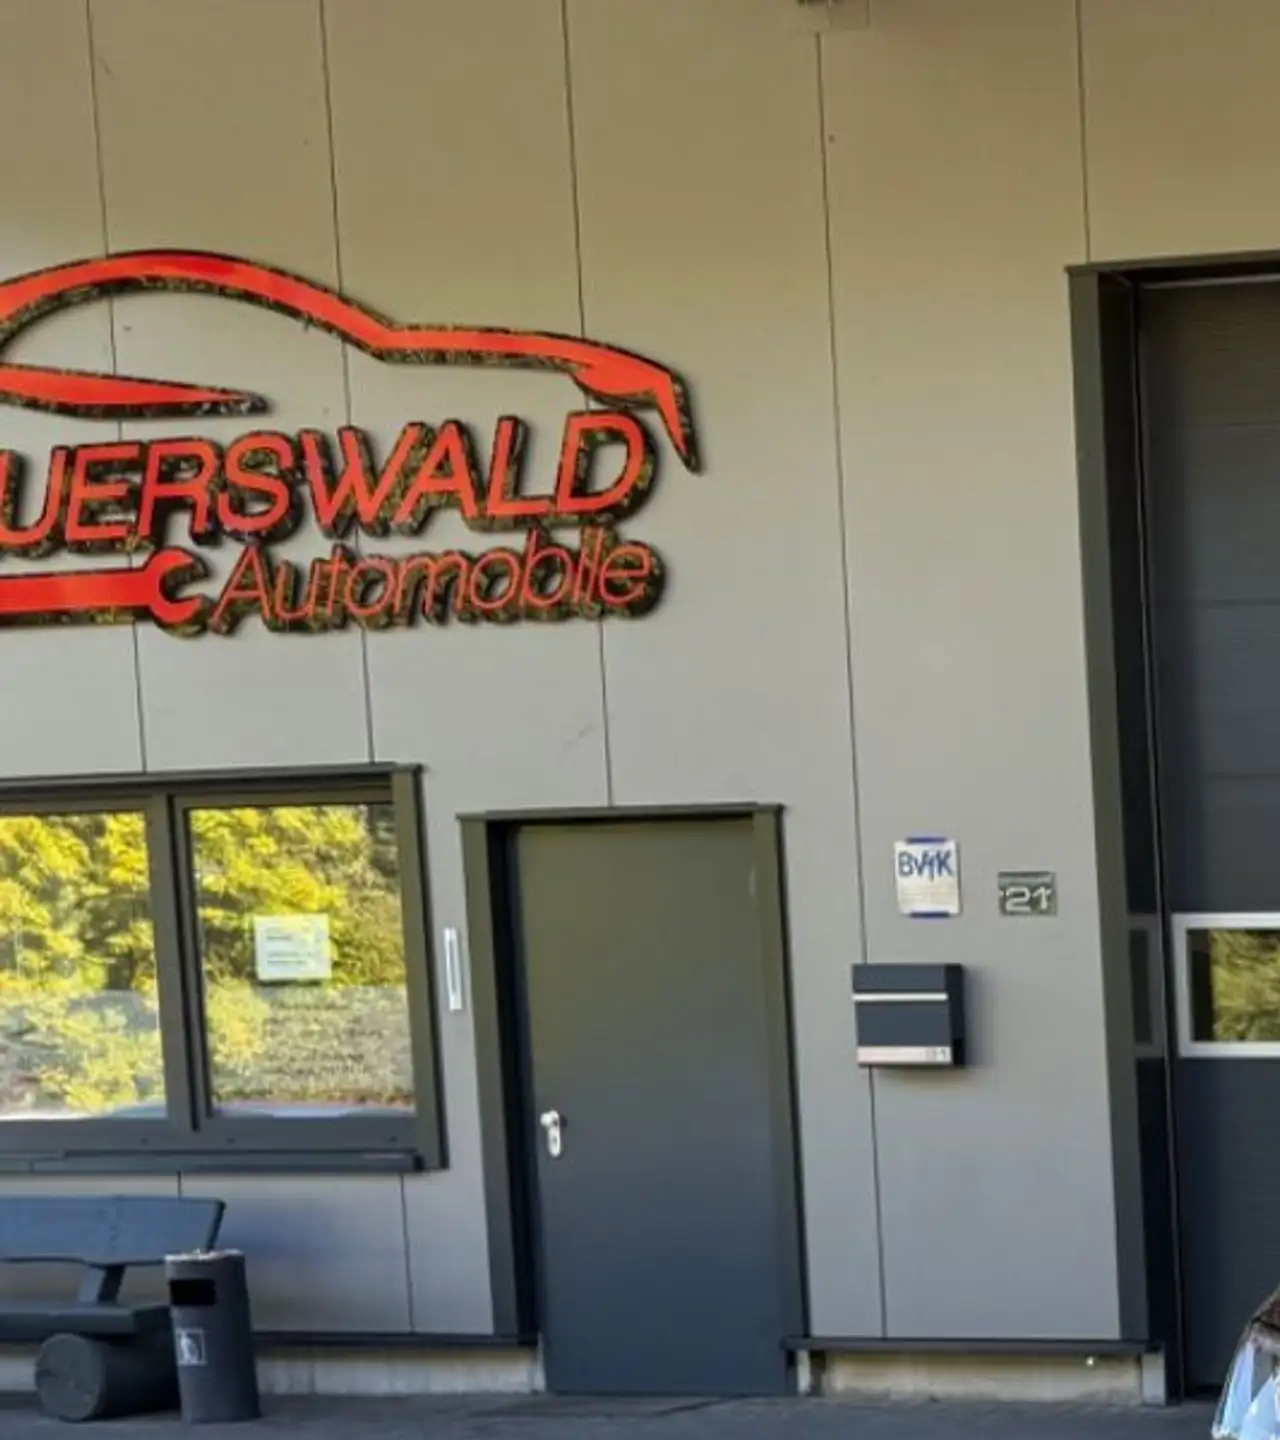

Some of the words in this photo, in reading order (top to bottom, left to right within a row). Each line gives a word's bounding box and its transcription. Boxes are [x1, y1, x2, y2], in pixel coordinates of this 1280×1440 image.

[0, 410, 653, 552] UERSWALD
[208, 527, 656, 634] Automobile
[1005, 886, 1052, 912] 21
